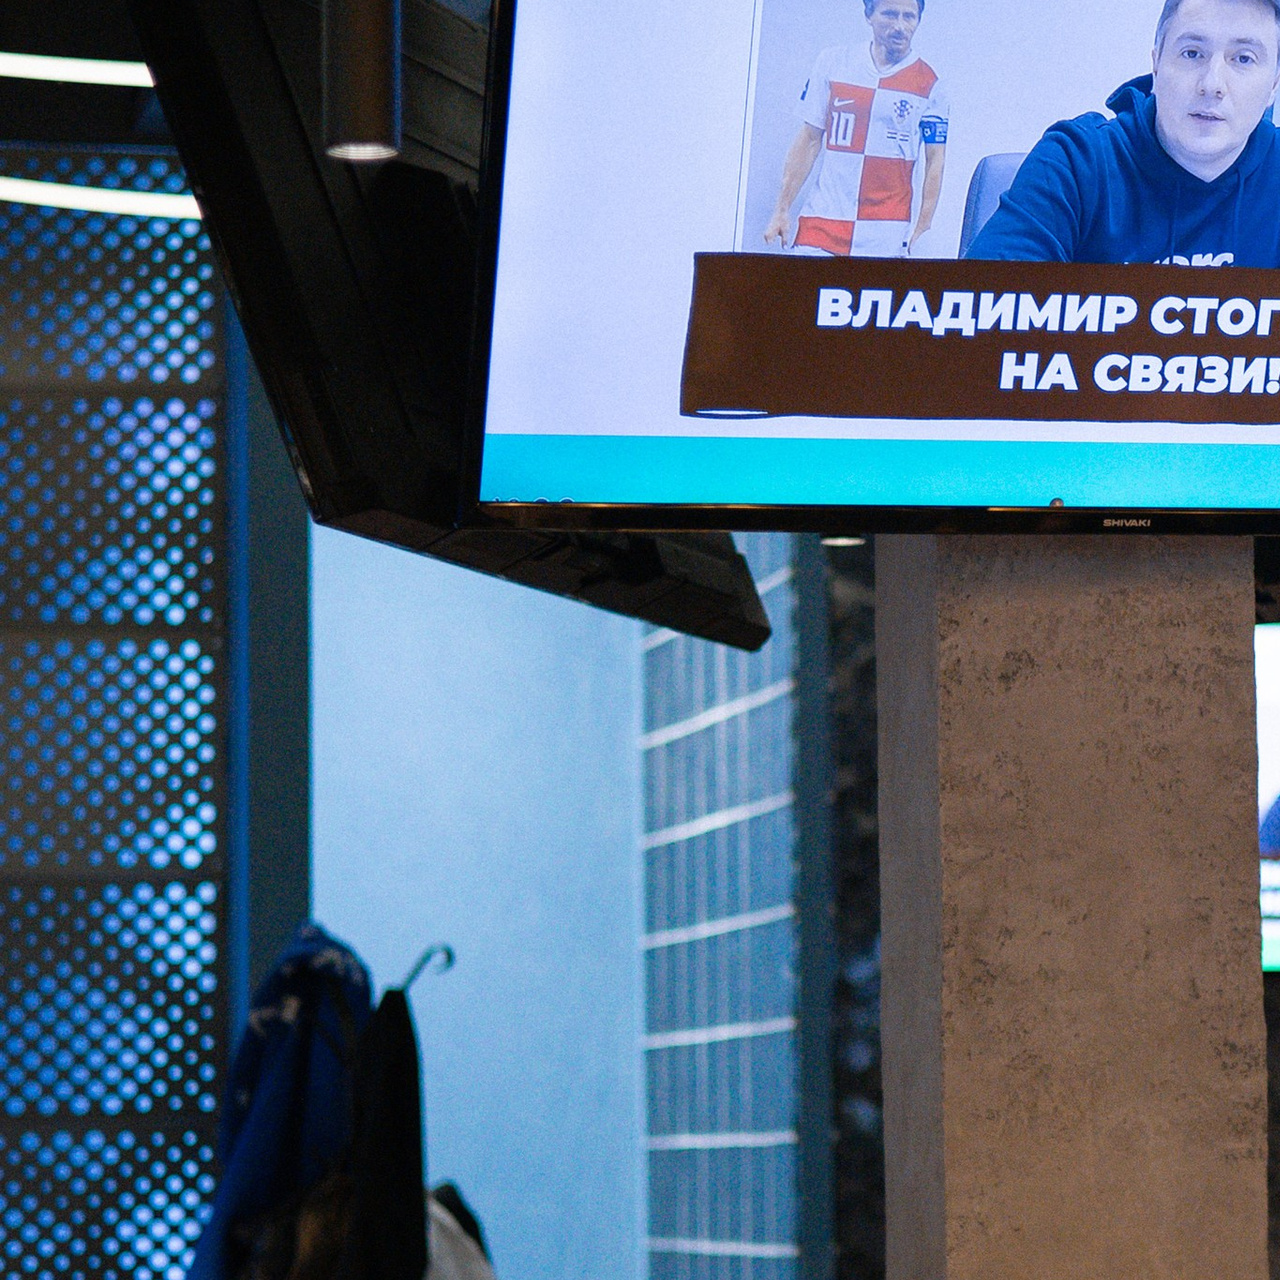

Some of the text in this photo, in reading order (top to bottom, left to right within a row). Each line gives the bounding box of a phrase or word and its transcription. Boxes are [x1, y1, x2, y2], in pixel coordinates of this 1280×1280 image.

[816, 287, 1138, 337] ВЛАДИМИР
[999, 352, 1079, 391] НА
[1102, 519, 1151, 527] SHIVAKI
